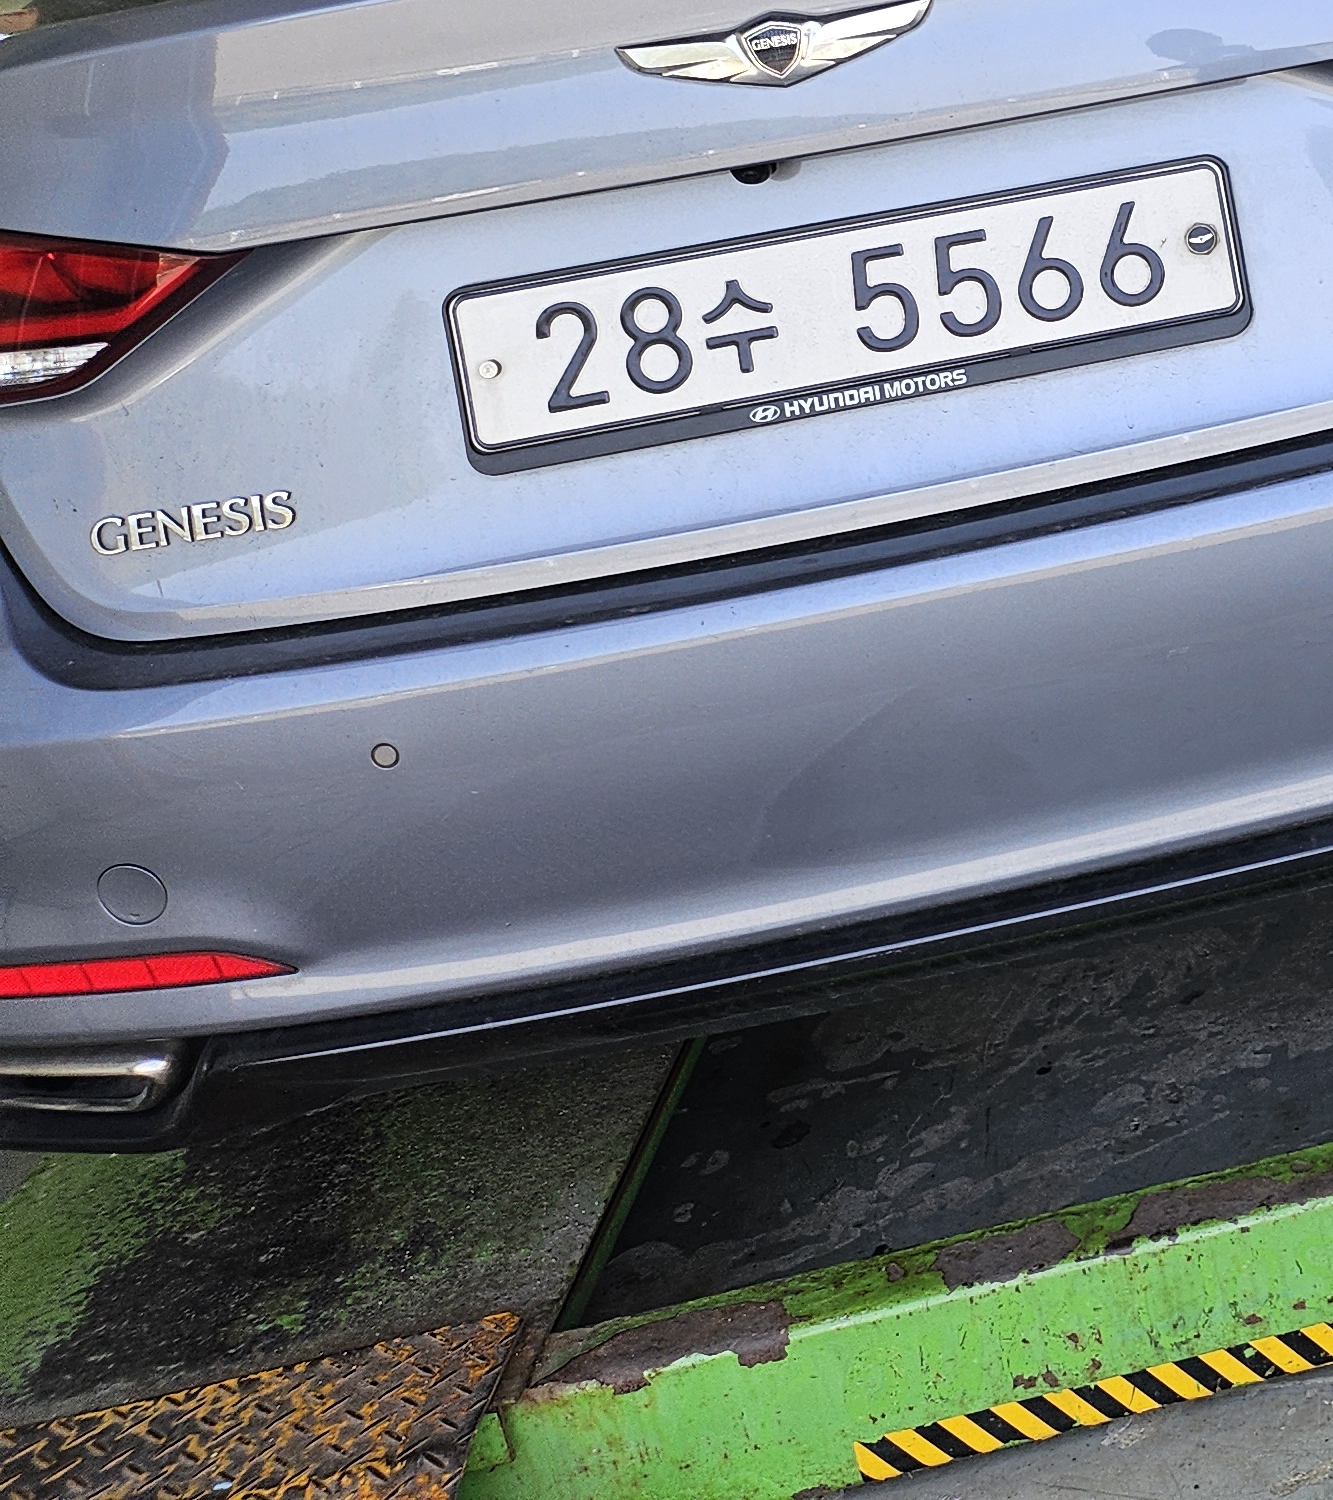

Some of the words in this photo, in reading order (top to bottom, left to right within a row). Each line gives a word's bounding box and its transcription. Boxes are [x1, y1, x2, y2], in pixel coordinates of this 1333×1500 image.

[751, 32, 798, 51] GENESIS
[534, 277, 780, 414] 28수
[849, 200, 1166, 353] 5566
[783, 383, 881, 418] HYUNDAI
[884, 367, 968, 399] MOTORS
[89, 488, 297, 556] GENESIS
